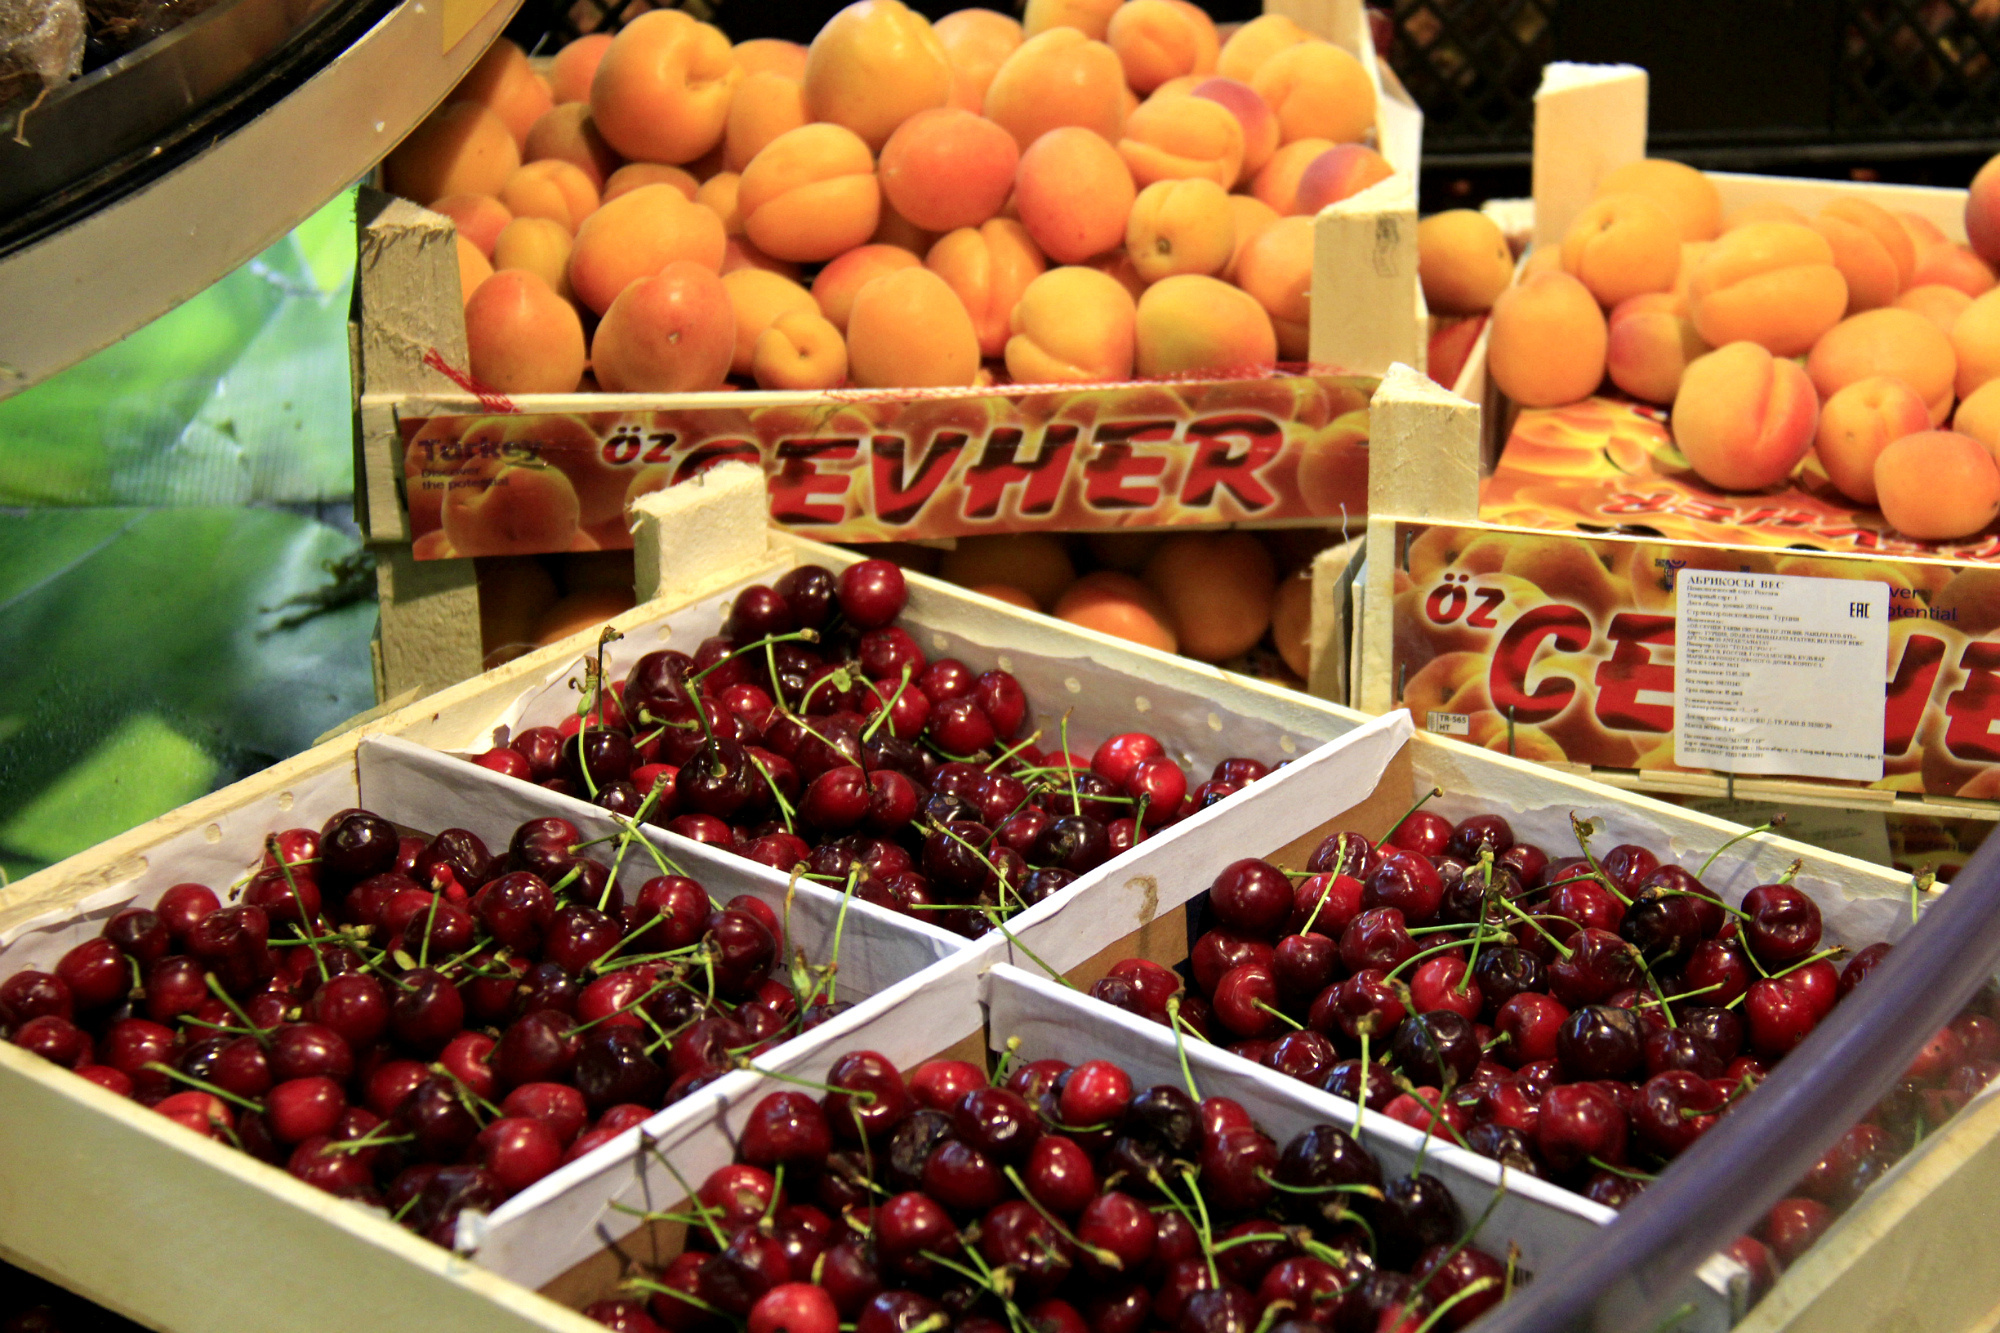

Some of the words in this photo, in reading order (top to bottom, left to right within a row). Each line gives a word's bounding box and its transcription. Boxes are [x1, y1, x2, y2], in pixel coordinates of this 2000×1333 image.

[1688, 576, 1754, 588] АБРИКОСЫ
[1761, 580, 1784, 589] ВЕС
[1889, 605, 1958, 621] otential
